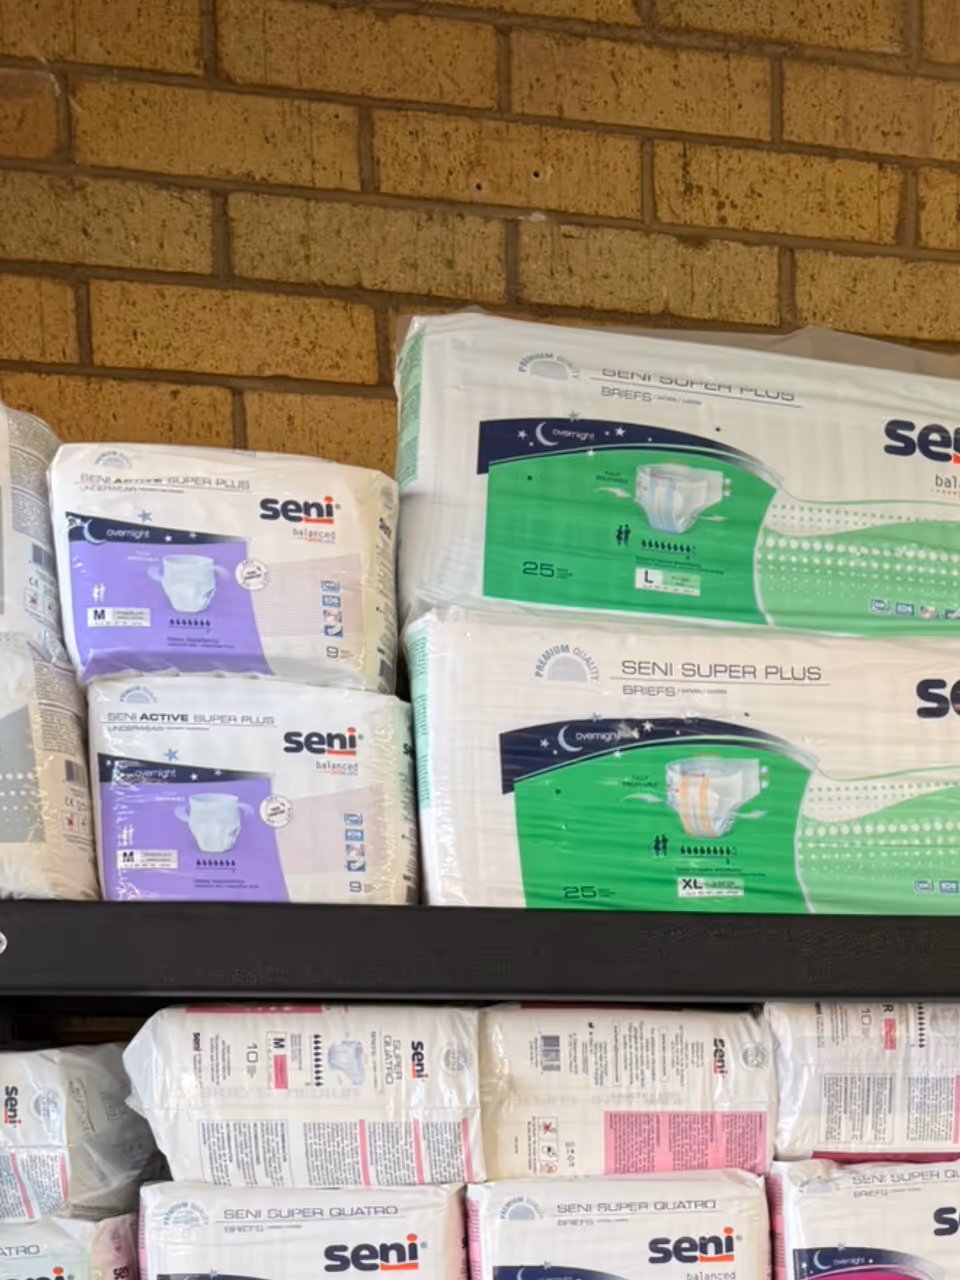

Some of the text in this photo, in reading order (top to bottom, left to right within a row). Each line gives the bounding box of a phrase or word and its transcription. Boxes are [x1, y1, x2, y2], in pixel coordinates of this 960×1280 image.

[600, 385, 653, 403] BRIEFS
[739, 384, 795, 402] PLUS
[551, 428, 595, 442] overnight
[259, 495, 338, 524] seni
[106, 528, 151, 541] overnight
[292, 527, 337, 540] balanced
[521, 561, 555, 578] 25
[643, 569, 654, 585] L
[93, 609, 106, 622] M
[326, 646, 340, 659] 9
[534, 644, 600, 681] PREMIUM QUALITY
[621, 660, 822, 681] SENI SUPER PLUS
[621, 684, 676, 697] BRIEFS
[139, 712, 275, 725] ACTIVE SUPER PLUS
[283, 728, 358, 757] seni
[681, 878, 704, 891] XL
[563, 885, 598, 899] 25
[272, 1037, 285, 1048] M
[247, 1043, 259, 1063] 10
[712, 1038, 728, 1079] seni
[411, 1040, 428, 1081] seni
[890, 1170, 941, 1184] SUPER
[223, 1205, 399, 1219] SENI SUPER QUATRO
[556, 1200, 717, 1213] SENI SUPER QUATRO
[0, 1244, 41, 1257] ATRO
[648, 1226, 735, 1264] seni
[323, 1233, 419, 1273] seni
